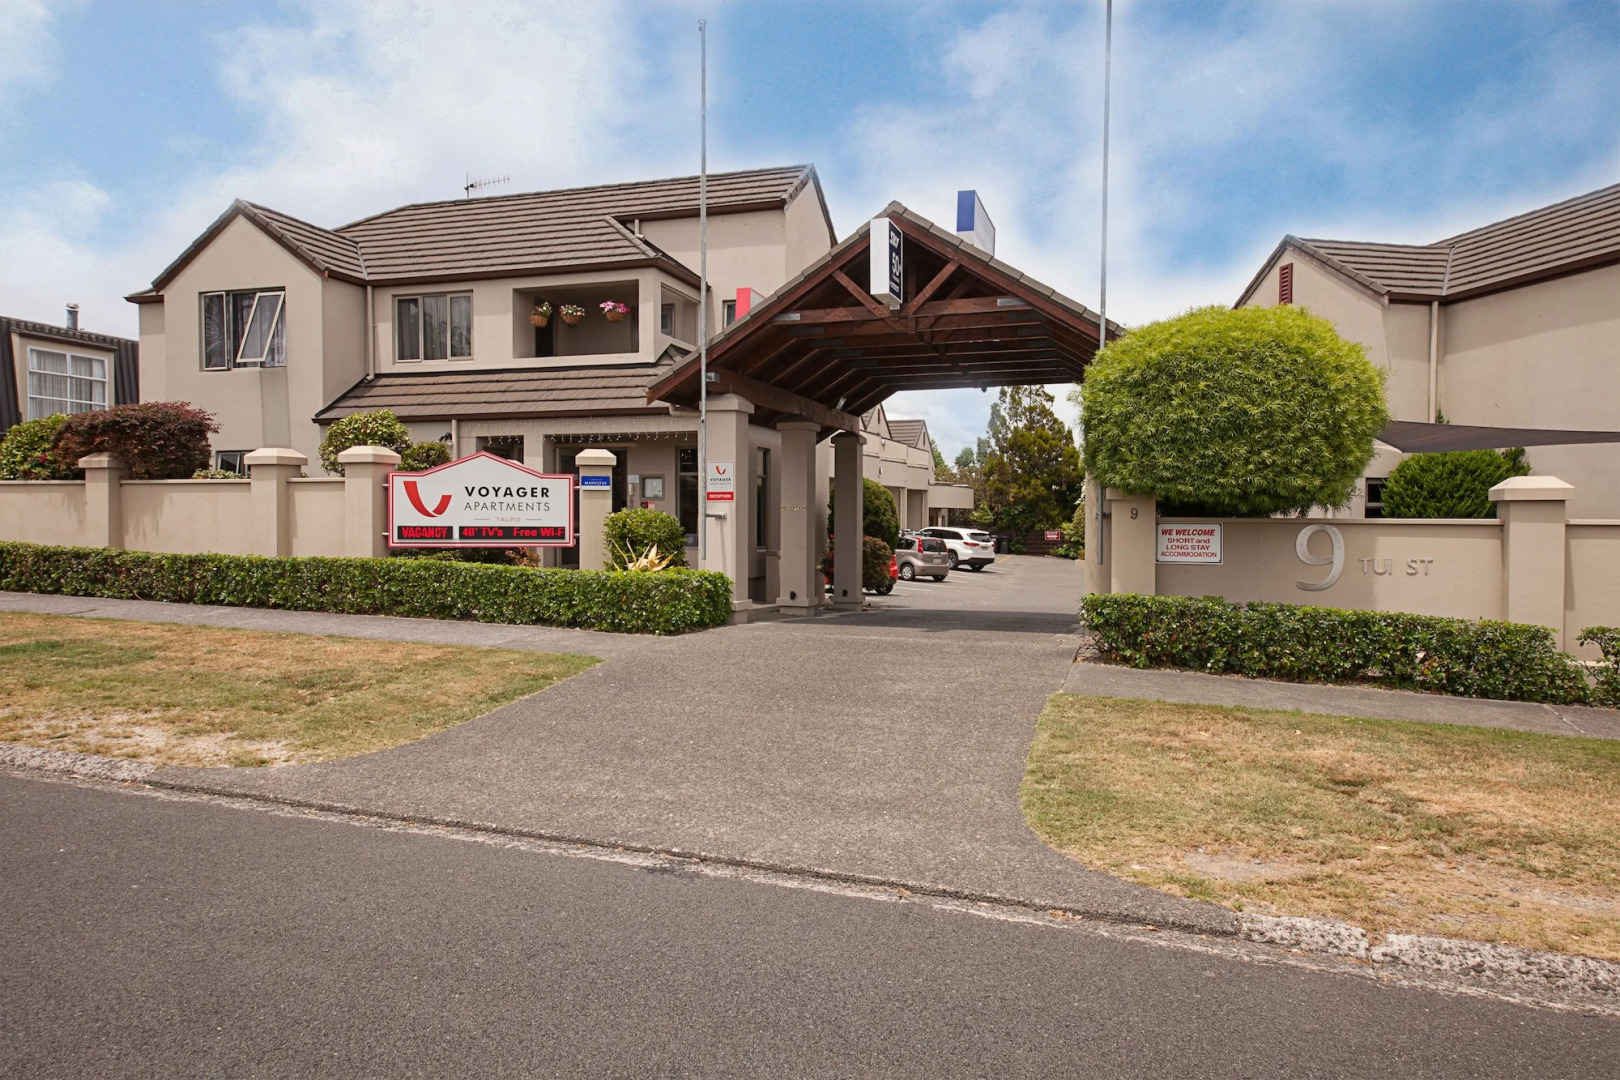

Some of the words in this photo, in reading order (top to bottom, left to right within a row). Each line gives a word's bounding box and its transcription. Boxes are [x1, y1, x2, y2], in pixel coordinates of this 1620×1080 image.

[464, 486, 550, 498] VOYAGER
[464, 501, 551, 512] APARTMENTS
[1130, 507, 1139, 520] 9
[401, 526, 448, 538] VACANCY
[480, 527, 504, 537] TV's
[513, 527, 538, 537] Free
[1161, 528, 1174, 536] WE
[1175, 528, 1216, 537] WELCOME
[1295, 523, 1345, 591] 9
[1359, 557, 1393, 576] TUI
[1406, 557, 1434, 577] ST
